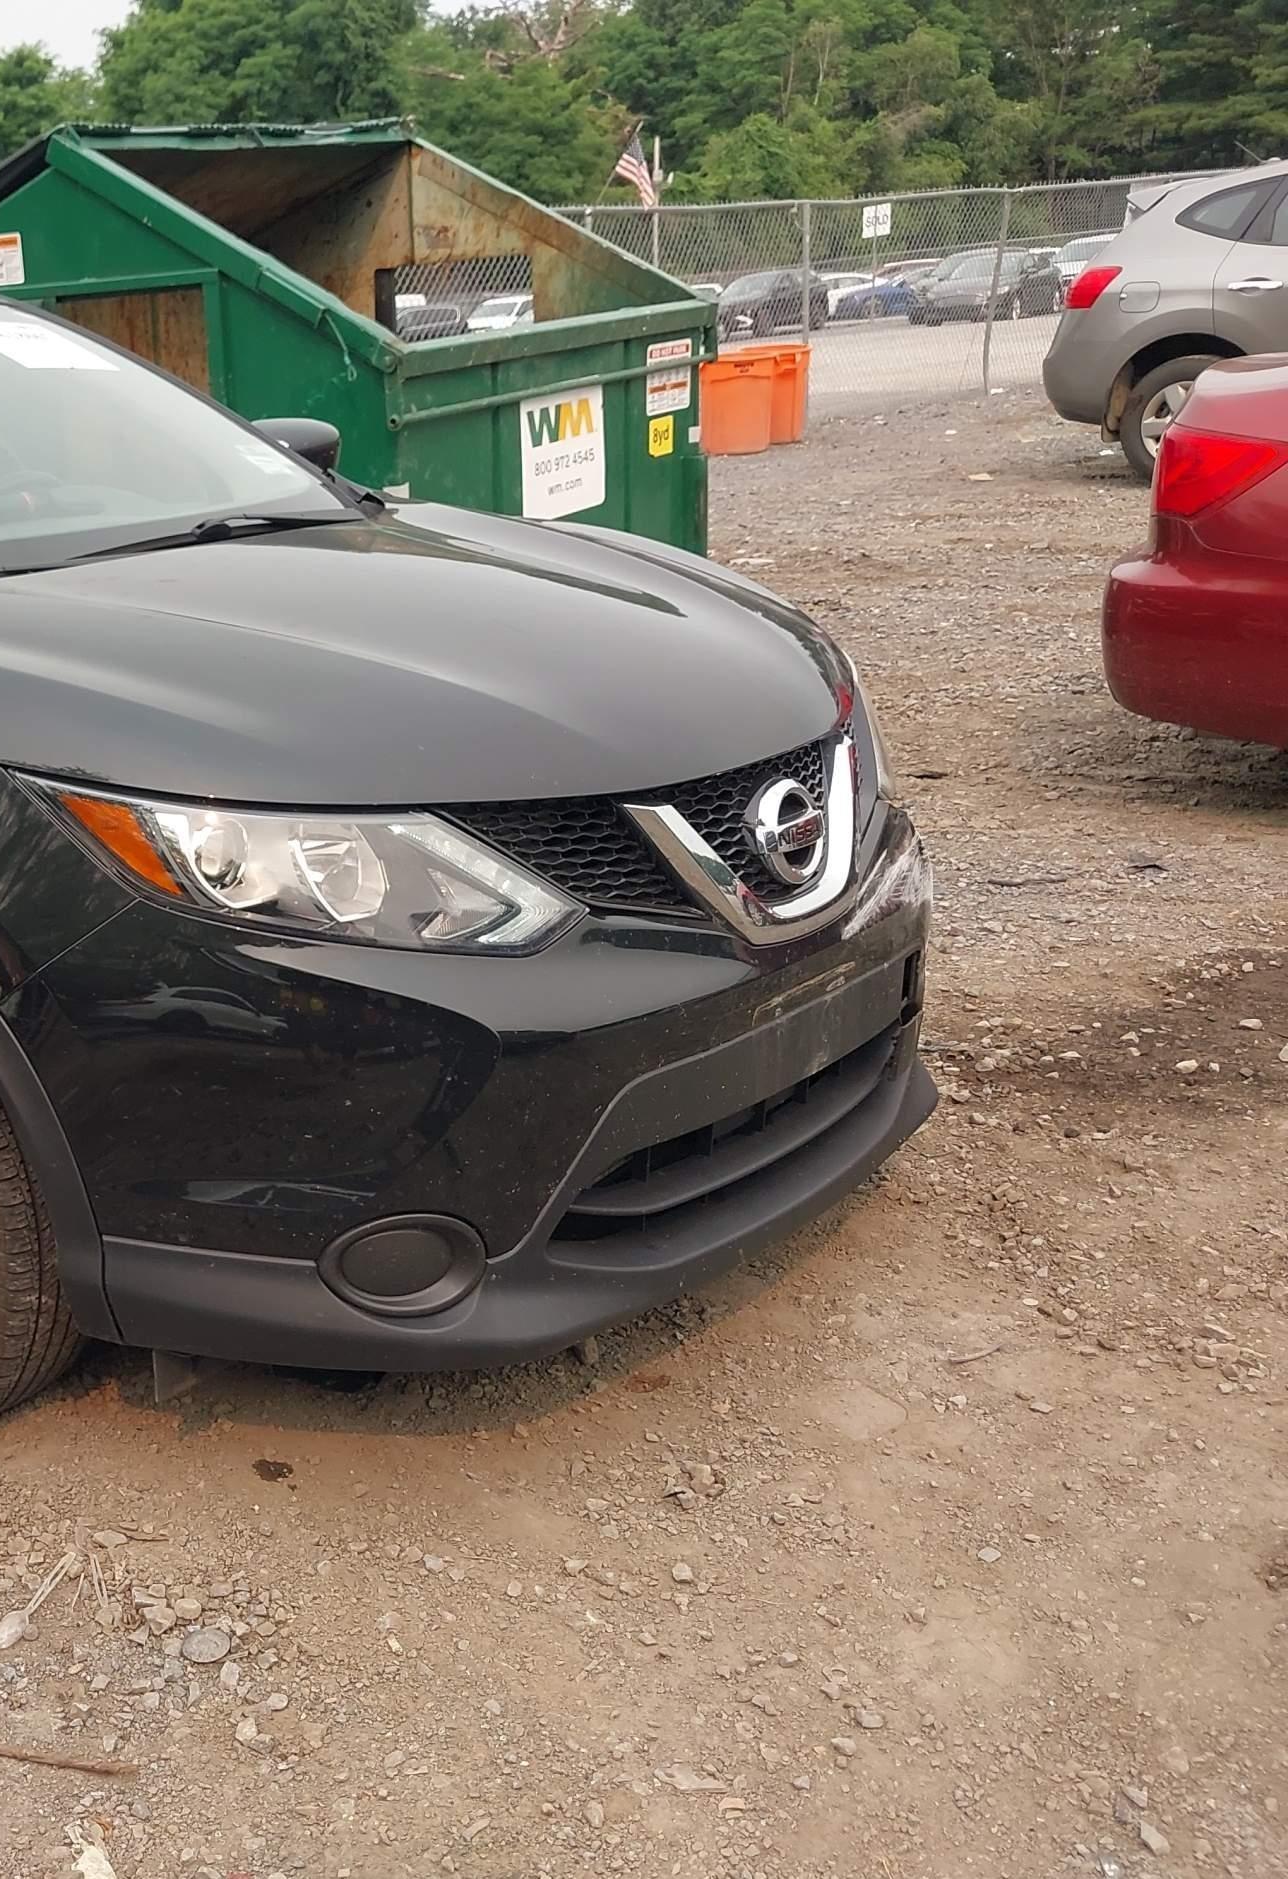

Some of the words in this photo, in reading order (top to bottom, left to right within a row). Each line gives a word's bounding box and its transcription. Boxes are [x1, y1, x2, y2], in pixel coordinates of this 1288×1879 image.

[865, 214, 889, 228] SOLD
[527, 398, 594, 448] WM
[653, 425, 670, 446] 8yd
[534, 459, 552, 477] 800
[554, 454, 570, 472] 972
[572, 448, 595, 466] 4545
[547, 477, 583, 496] wm.com
